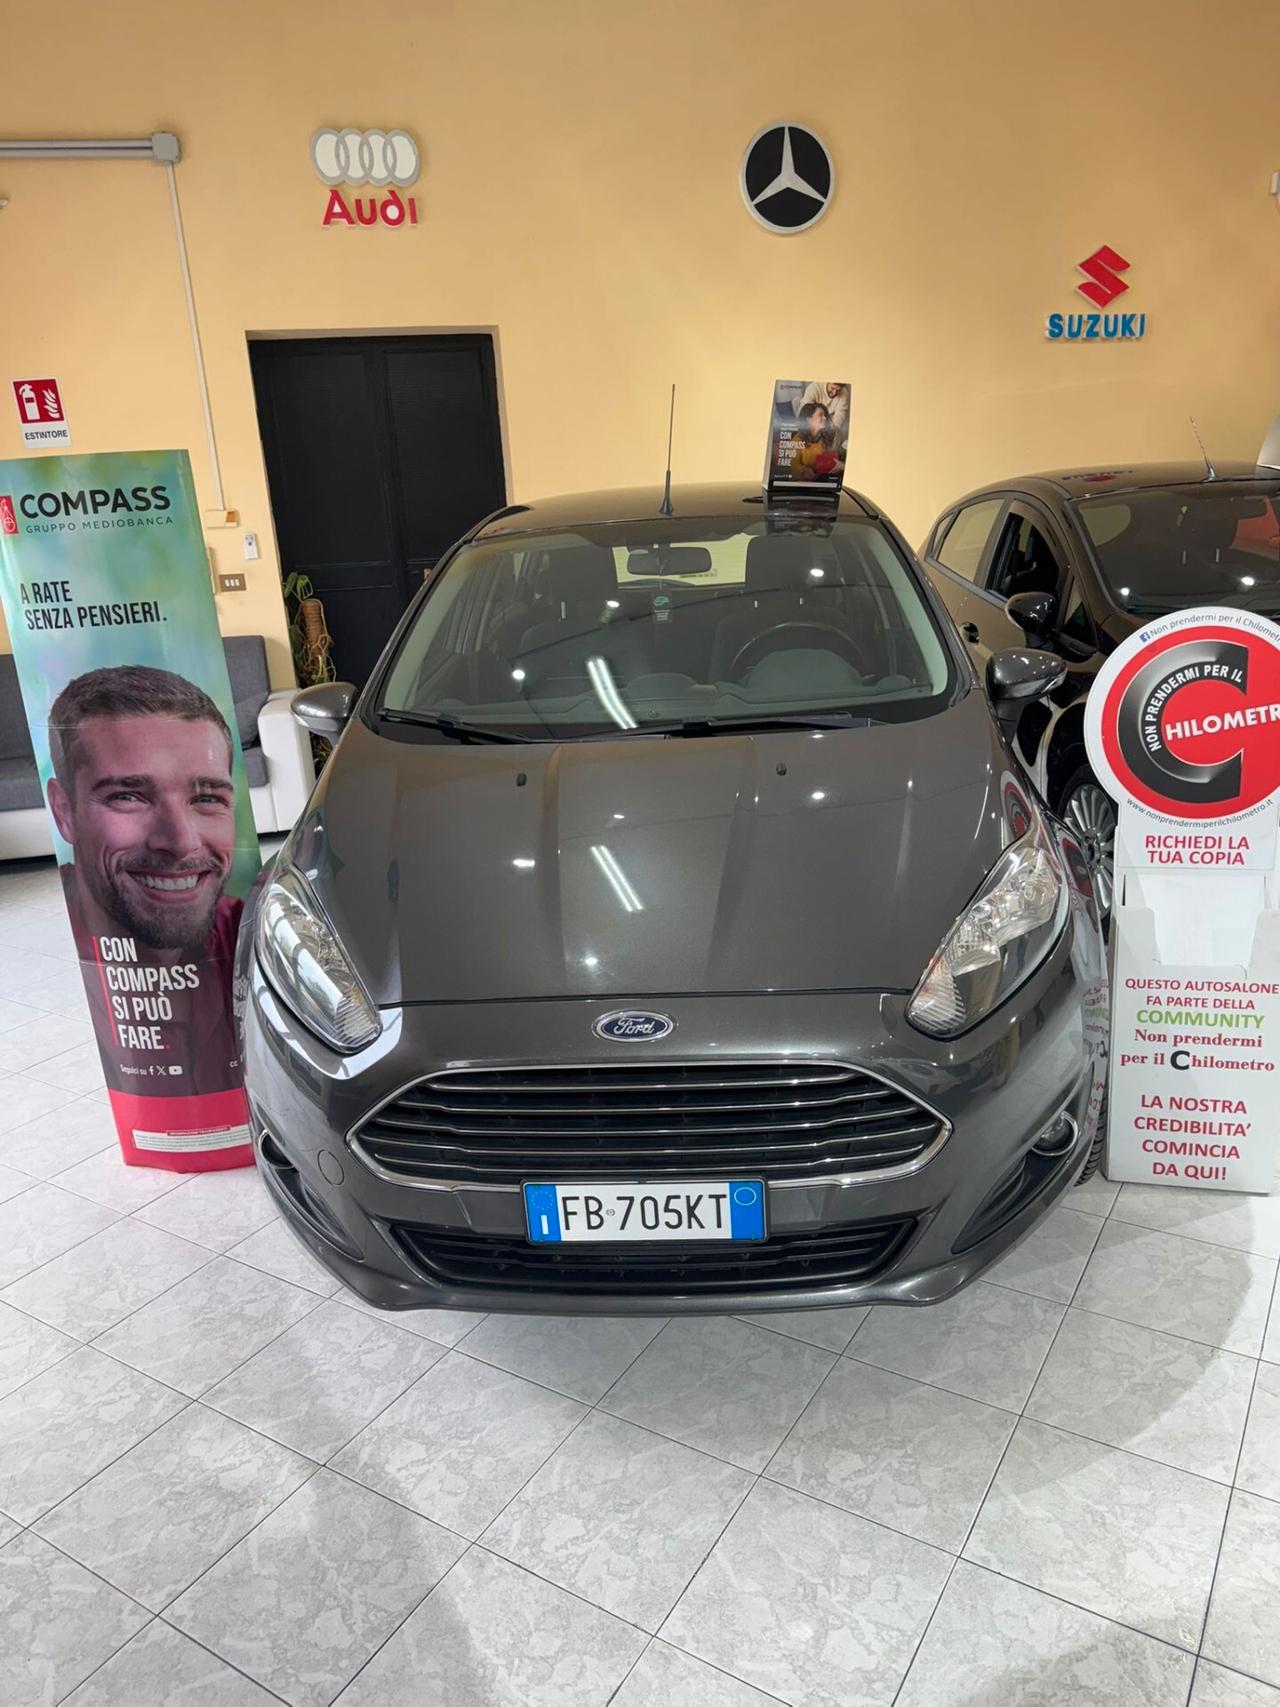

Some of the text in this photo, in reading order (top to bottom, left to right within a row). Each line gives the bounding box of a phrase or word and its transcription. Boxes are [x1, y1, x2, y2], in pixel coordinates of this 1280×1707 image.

[322, 189, 418, 227] Audi
[1047, 313, 1146, 339] SUZUKI
[24, 429, 68, 441] ESTINTORE
[20, 486, 171, 519] COMPASS
[26, 516, 173, 534] GRUPPO MEDIOBANCA
[20, 580, 73, 605] A RATE
[24, 601, 168, 630] SENZA PENSIERI.
[1150, 624, 1168, 637] Non
[1169, 614, 1216, 630] prendermi
[1218, 616, 1234, 625] per
[1235, 616, 1242, 624] il
[1145, 664, 1243, 752] NON PRENDERMI PER IL
[1145, 834, 1249, 850] RICHIEDI LA
[1147, 850, 1245, 865] TUA COPIA
[100, 936, 138, 962] CON
[105, 964, 200, 992] COMPASS
[1125, 977, 1279, 995] QUESTO AUTOSALONE
[112, 992, 173, 1021] SI PUÒ
[1146, 995, 1255, 1010] FA PARTE DELLA
[612, 1016, 656, 1036] Ford
[1136, 1009, 1265, 1029] COMMUNITY
[1134, 1029, 1262, 1048] Non prendermi
[1120, 1053, 1148, 1066] per
[1153, 1053, 1165, 1065] il
[1141, 1094, 1247, 1114] LA NOSTRA
[1142, 1139, 1240, 1159] COMINCIA
[1153, 1162, 1227, 1180] DA QUI!
